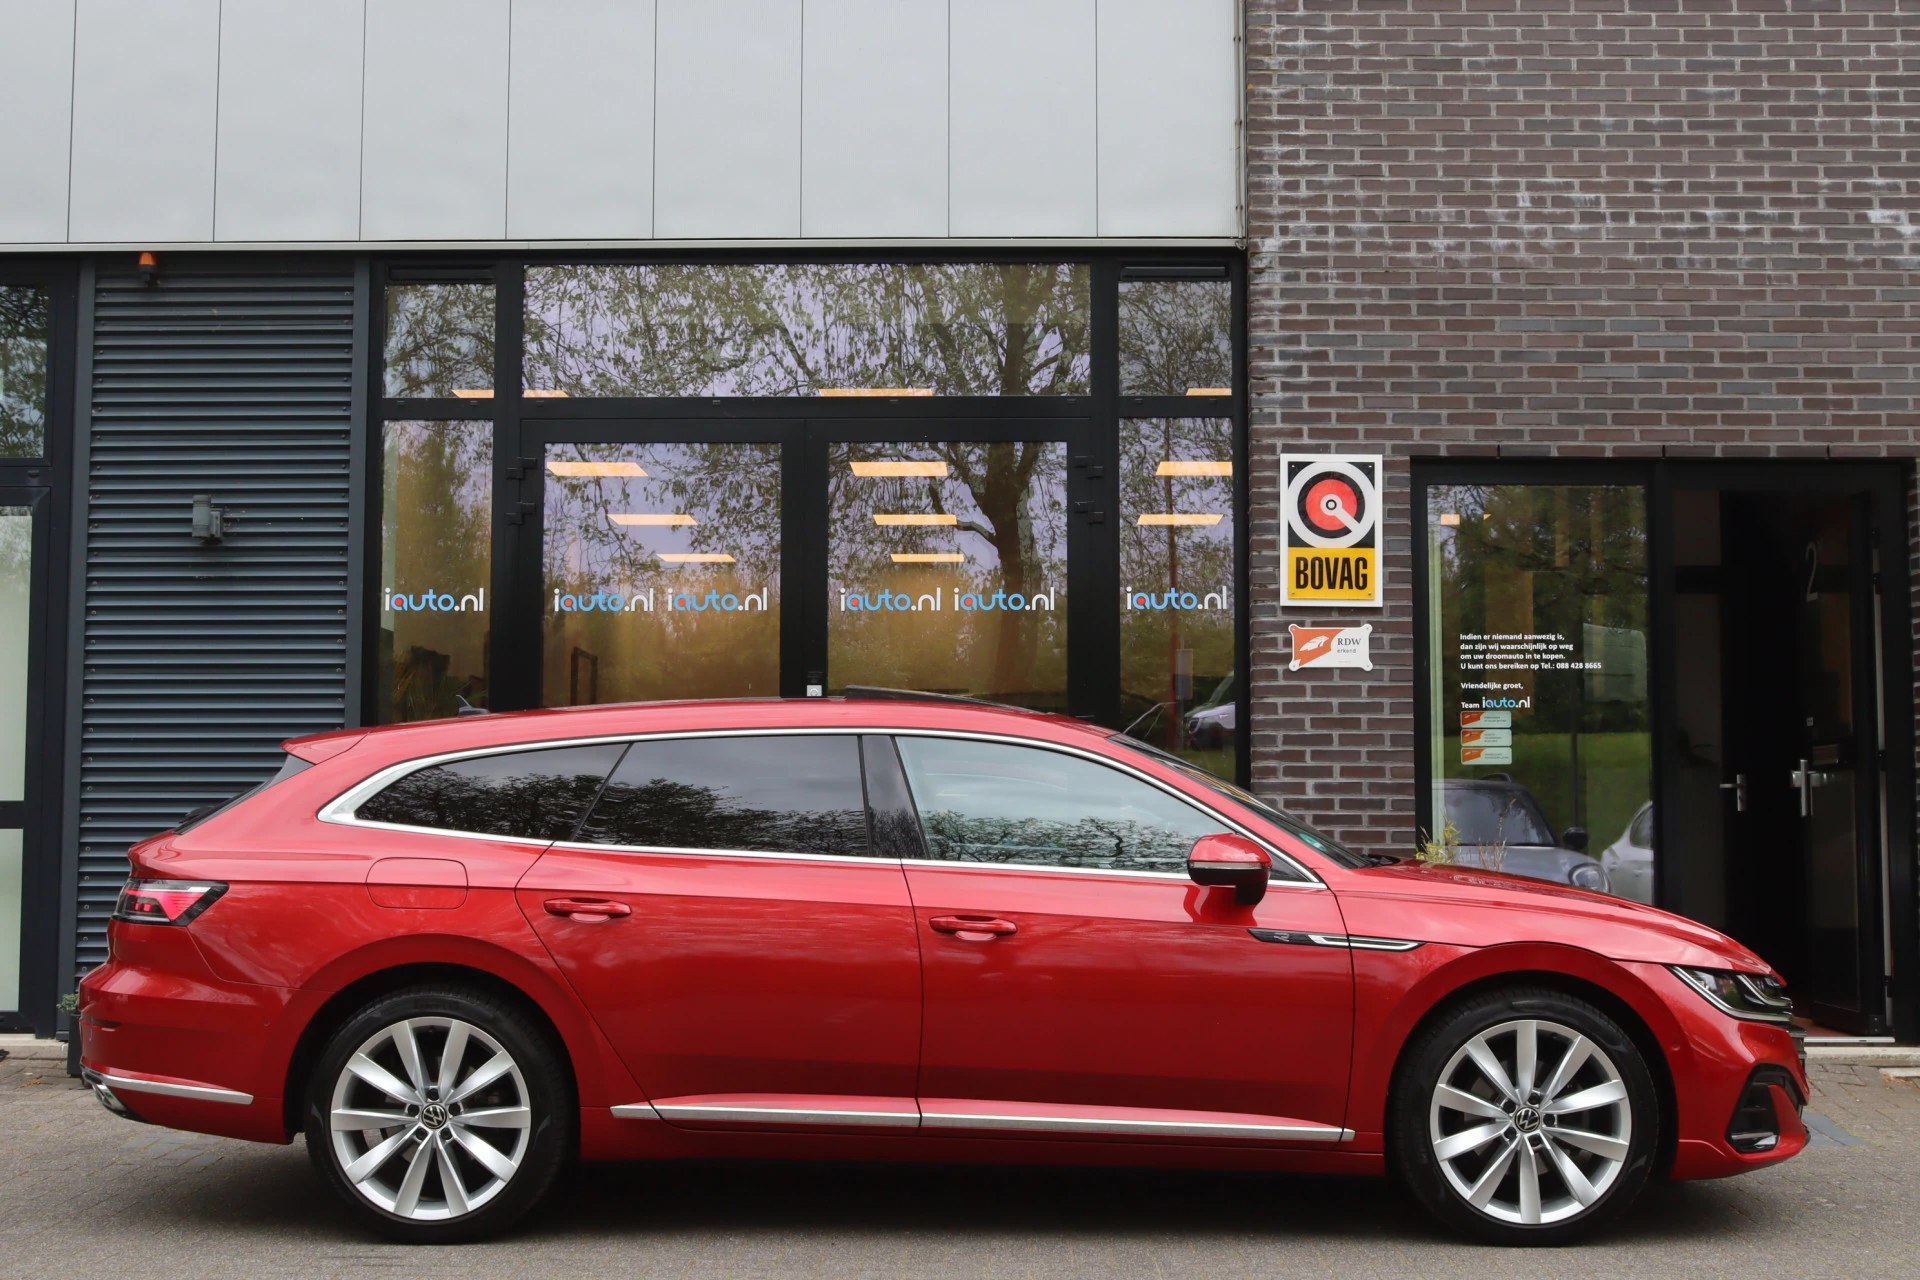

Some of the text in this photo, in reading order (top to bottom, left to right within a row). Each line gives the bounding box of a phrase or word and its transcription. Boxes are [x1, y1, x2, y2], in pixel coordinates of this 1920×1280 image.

[1295, 557, 1368, 591] BOVAG
[384, 587, 485, 612] iauto.nl
[553, 588, 654, 612] iauto.nl
[667, 587, 768, 612] iauto.nl
[840, 587, 941, 612] iauto.nl
[953, 586, 1055, 611] iauto.nl
[1126, 585, 1228, 610] iauto.nl
[1337, 637, 1361, 646] RDW
[1524, 633, 1556, 641] aanwezig
[1556, 633, 1565, 641] is,
[1475, 643, 1487, 651] zijn
[1488, 643, 1499, 651] wij
[1500, 642, 1547, 651] waarschijnlijk
[1485, 652, 1524, 660] droomauto
[1525, 652, 1533, 660] in
[1542, 652, 1566, 661] kopen.
[1460, 662, 1467, 670] U
[1467, 662, 1484, 670] kunt
[1498, 662, 1529, 670] bereiken
[1540, 662, 1556, 670] Tel.:
[1556, 662, 1569, 670] 088
[1570, 662, 1584, 670] 428
[1584, 662, 1602, 670] 8665
[1460, 682, 1502, 690] Vriendelijke
[1461, 696, 1531, 709] Team iauto.nl
